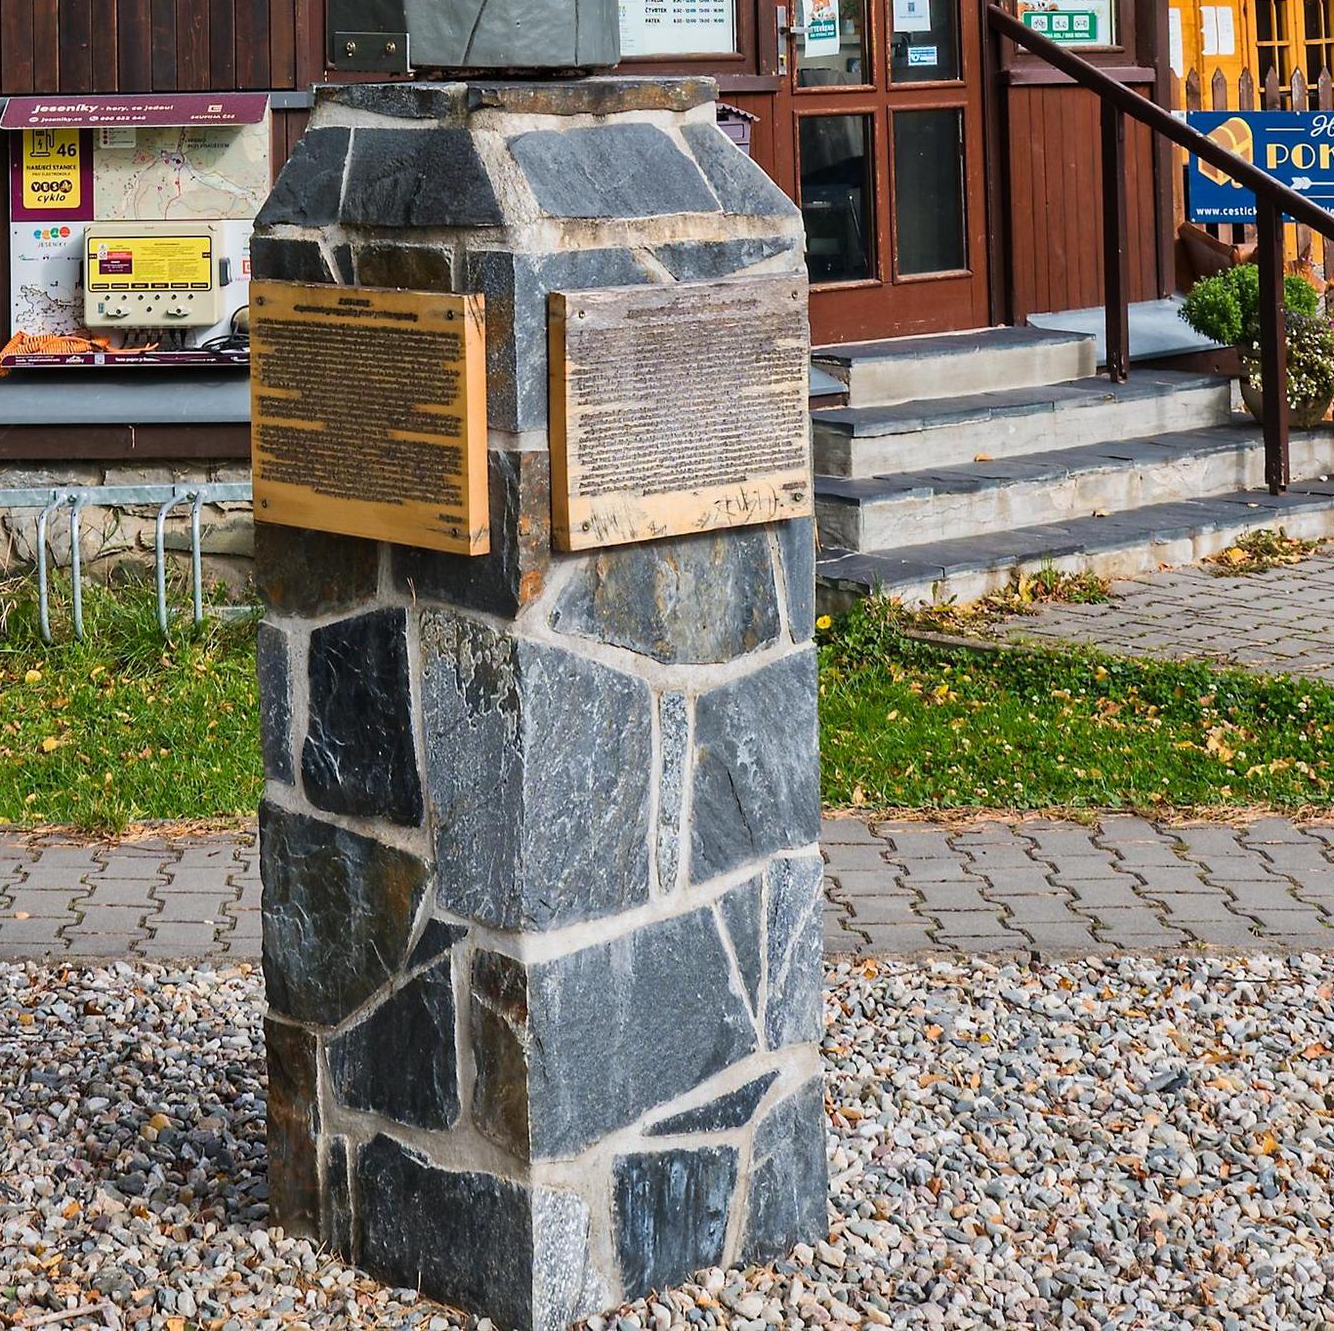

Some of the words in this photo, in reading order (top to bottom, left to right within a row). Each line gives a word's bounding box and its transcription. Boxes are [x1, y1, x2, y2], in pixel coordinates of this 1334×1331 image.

[31, 103, 100, 115] Jeseníky
[56, 143, 77, 158] 46
[37, 193, 66, 204] cyklo
